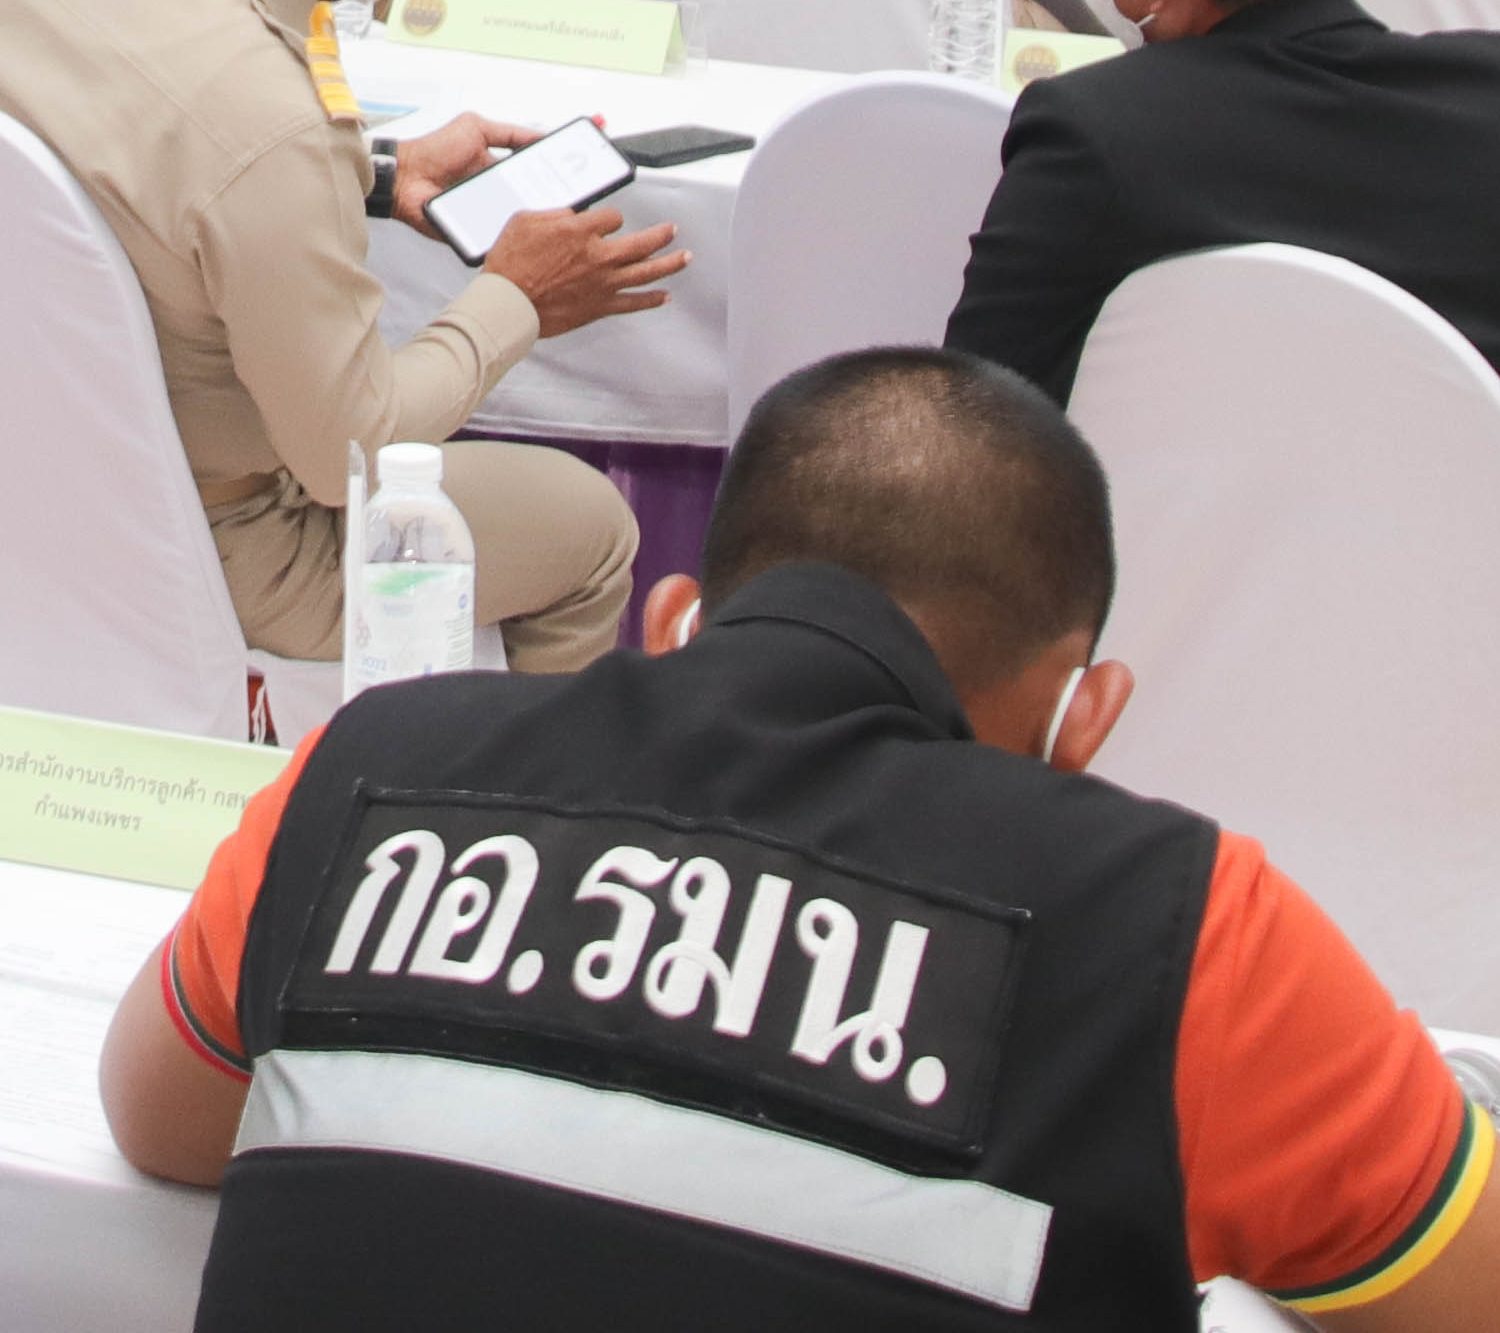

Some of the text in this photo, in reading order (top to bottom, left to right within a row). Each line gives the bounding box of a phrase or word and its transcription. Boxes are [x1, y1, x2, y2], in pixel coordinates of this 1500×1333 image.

[34, 794, 144, 832] กำแพงเพชร
[324, 829, 948, 1105] กอ.รมน.
